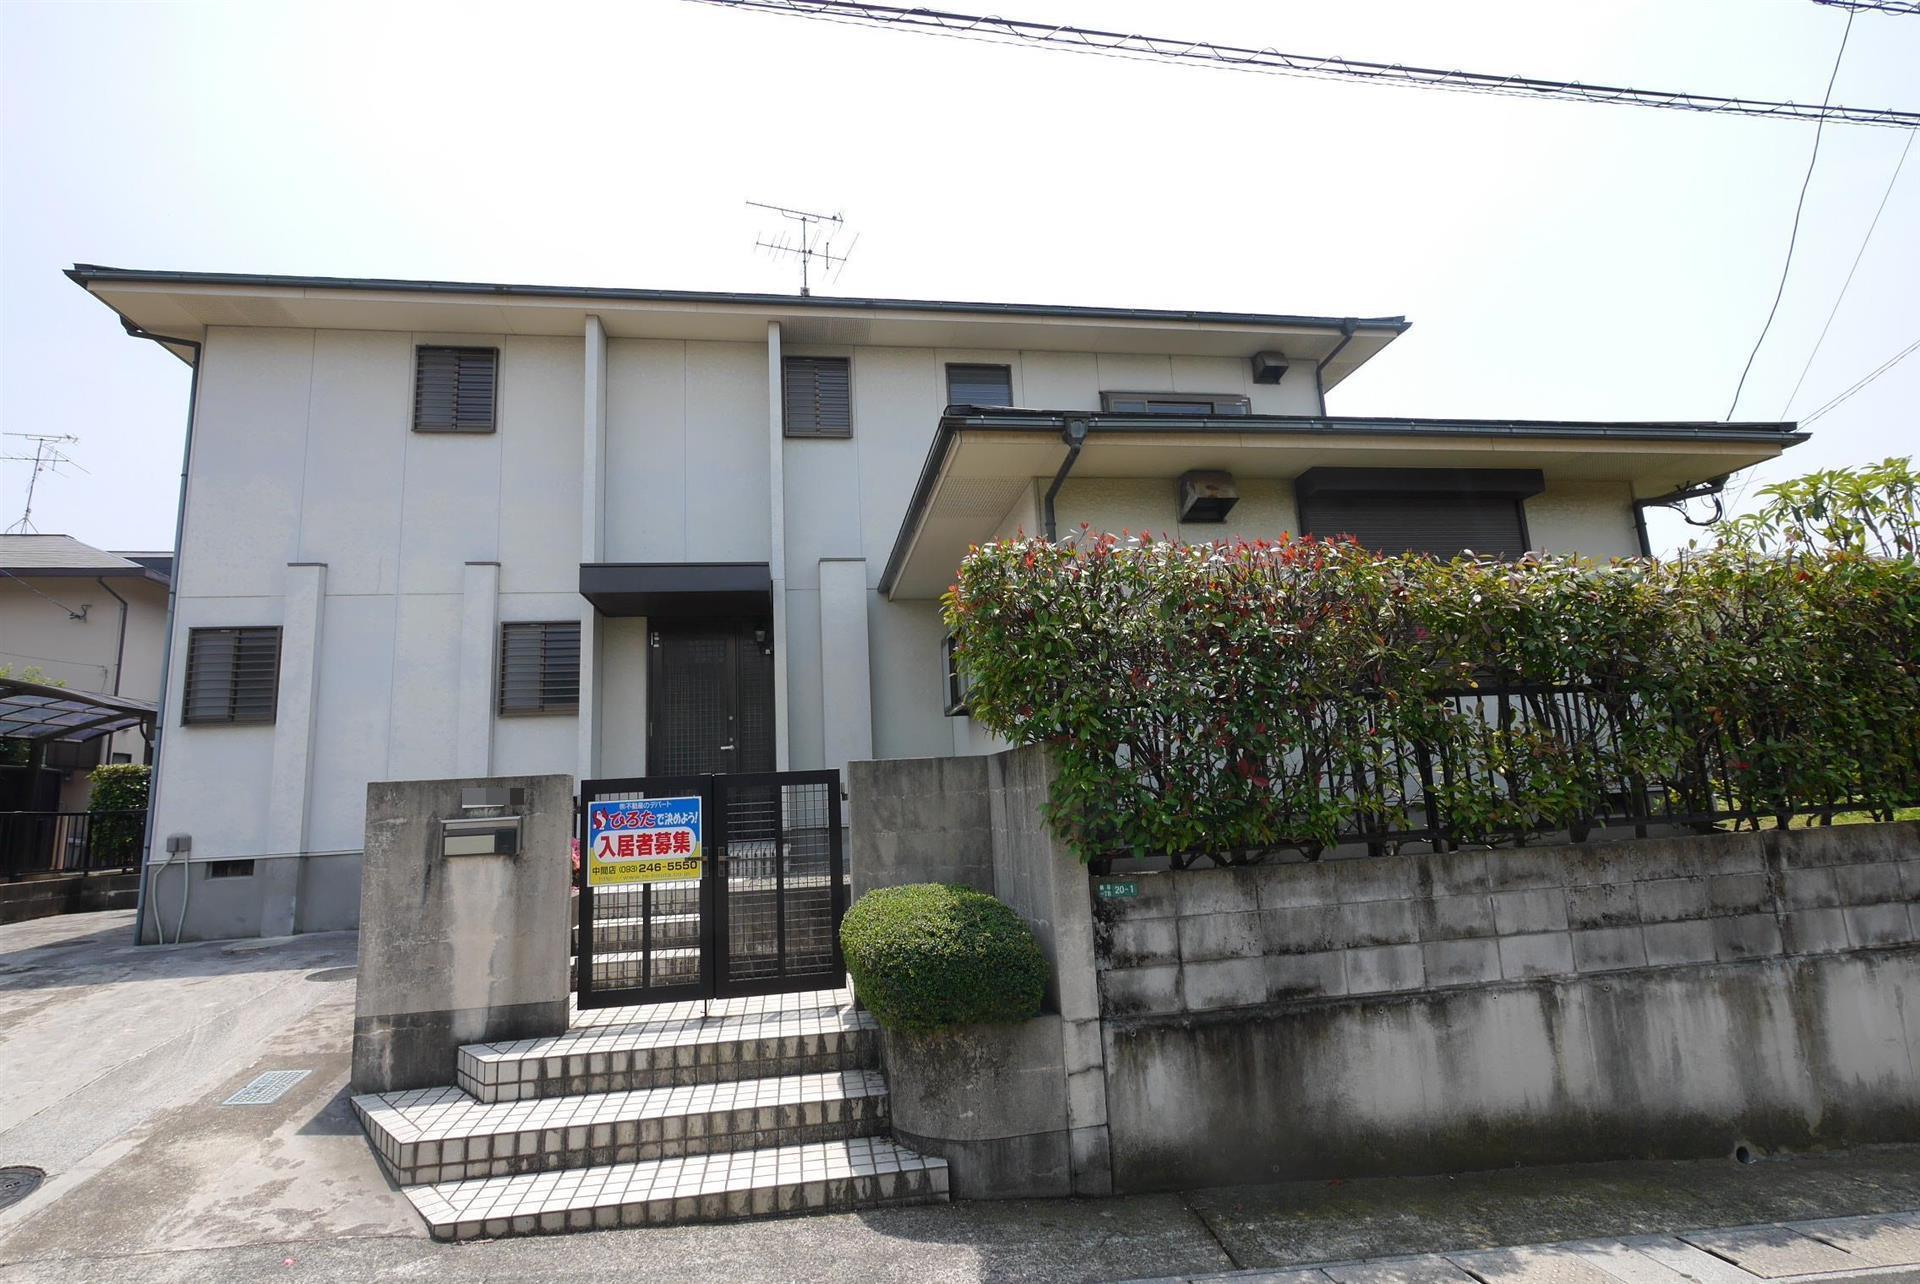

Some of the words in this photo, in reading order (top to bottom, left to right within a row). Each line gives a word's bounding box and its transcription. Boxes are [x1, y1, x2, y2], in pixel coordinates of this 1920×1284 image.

[598, 831, 690, 859] 入居者募集
[639, 860, 698, 873] 246-5550
[1114, 884, 1134, 895] 20-1
